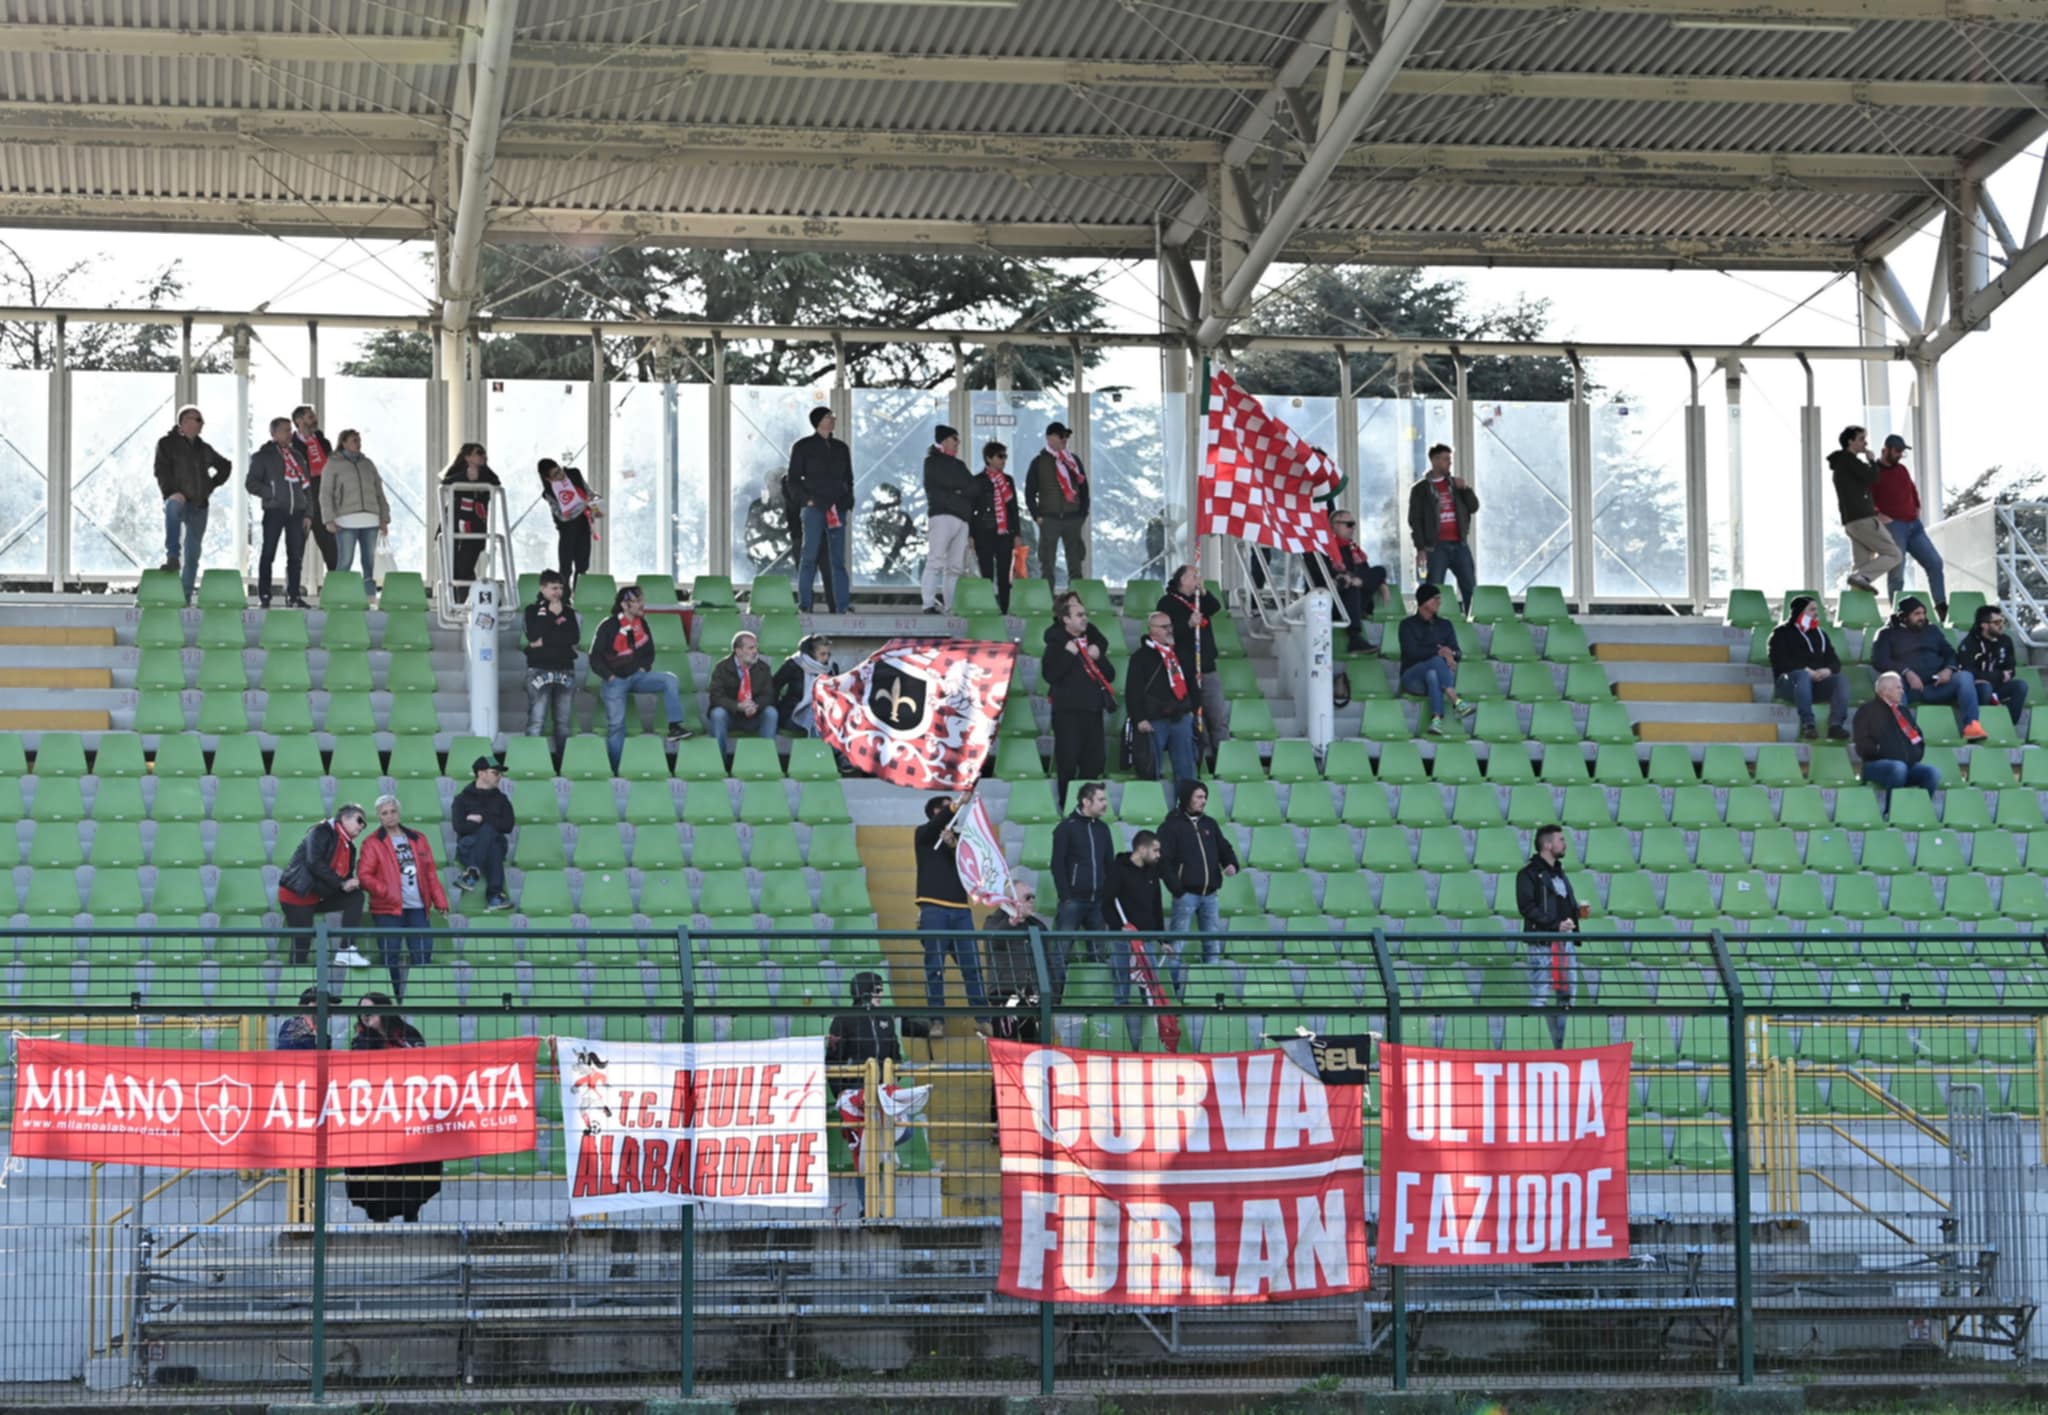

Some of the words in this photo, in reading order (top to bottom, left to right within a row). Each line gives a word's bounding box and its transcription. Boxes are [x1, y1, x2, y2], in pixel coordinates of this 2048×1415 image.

[23, 1064, 183, 1124] MILANO
[264, 1063, 529, 1128] ALABARDATA
[404, 1120, 476, 1136] TRIESTINA
[480, 1114, 518, 1128] CLUB
[619, 1091, 663, 1128] T.C.
[669, 1065, 781, 1128] MULE
[1023, 1050, 1334, 1153] CURVA
[1406, 1059, 1605, 1144] ULTIMA
[573, 1133, 817, 1197] ALABARDATE
[1018, 1189, 1349, 1296] FURLAN
[1395, 1168, 1611, 1255] FAZIONE
